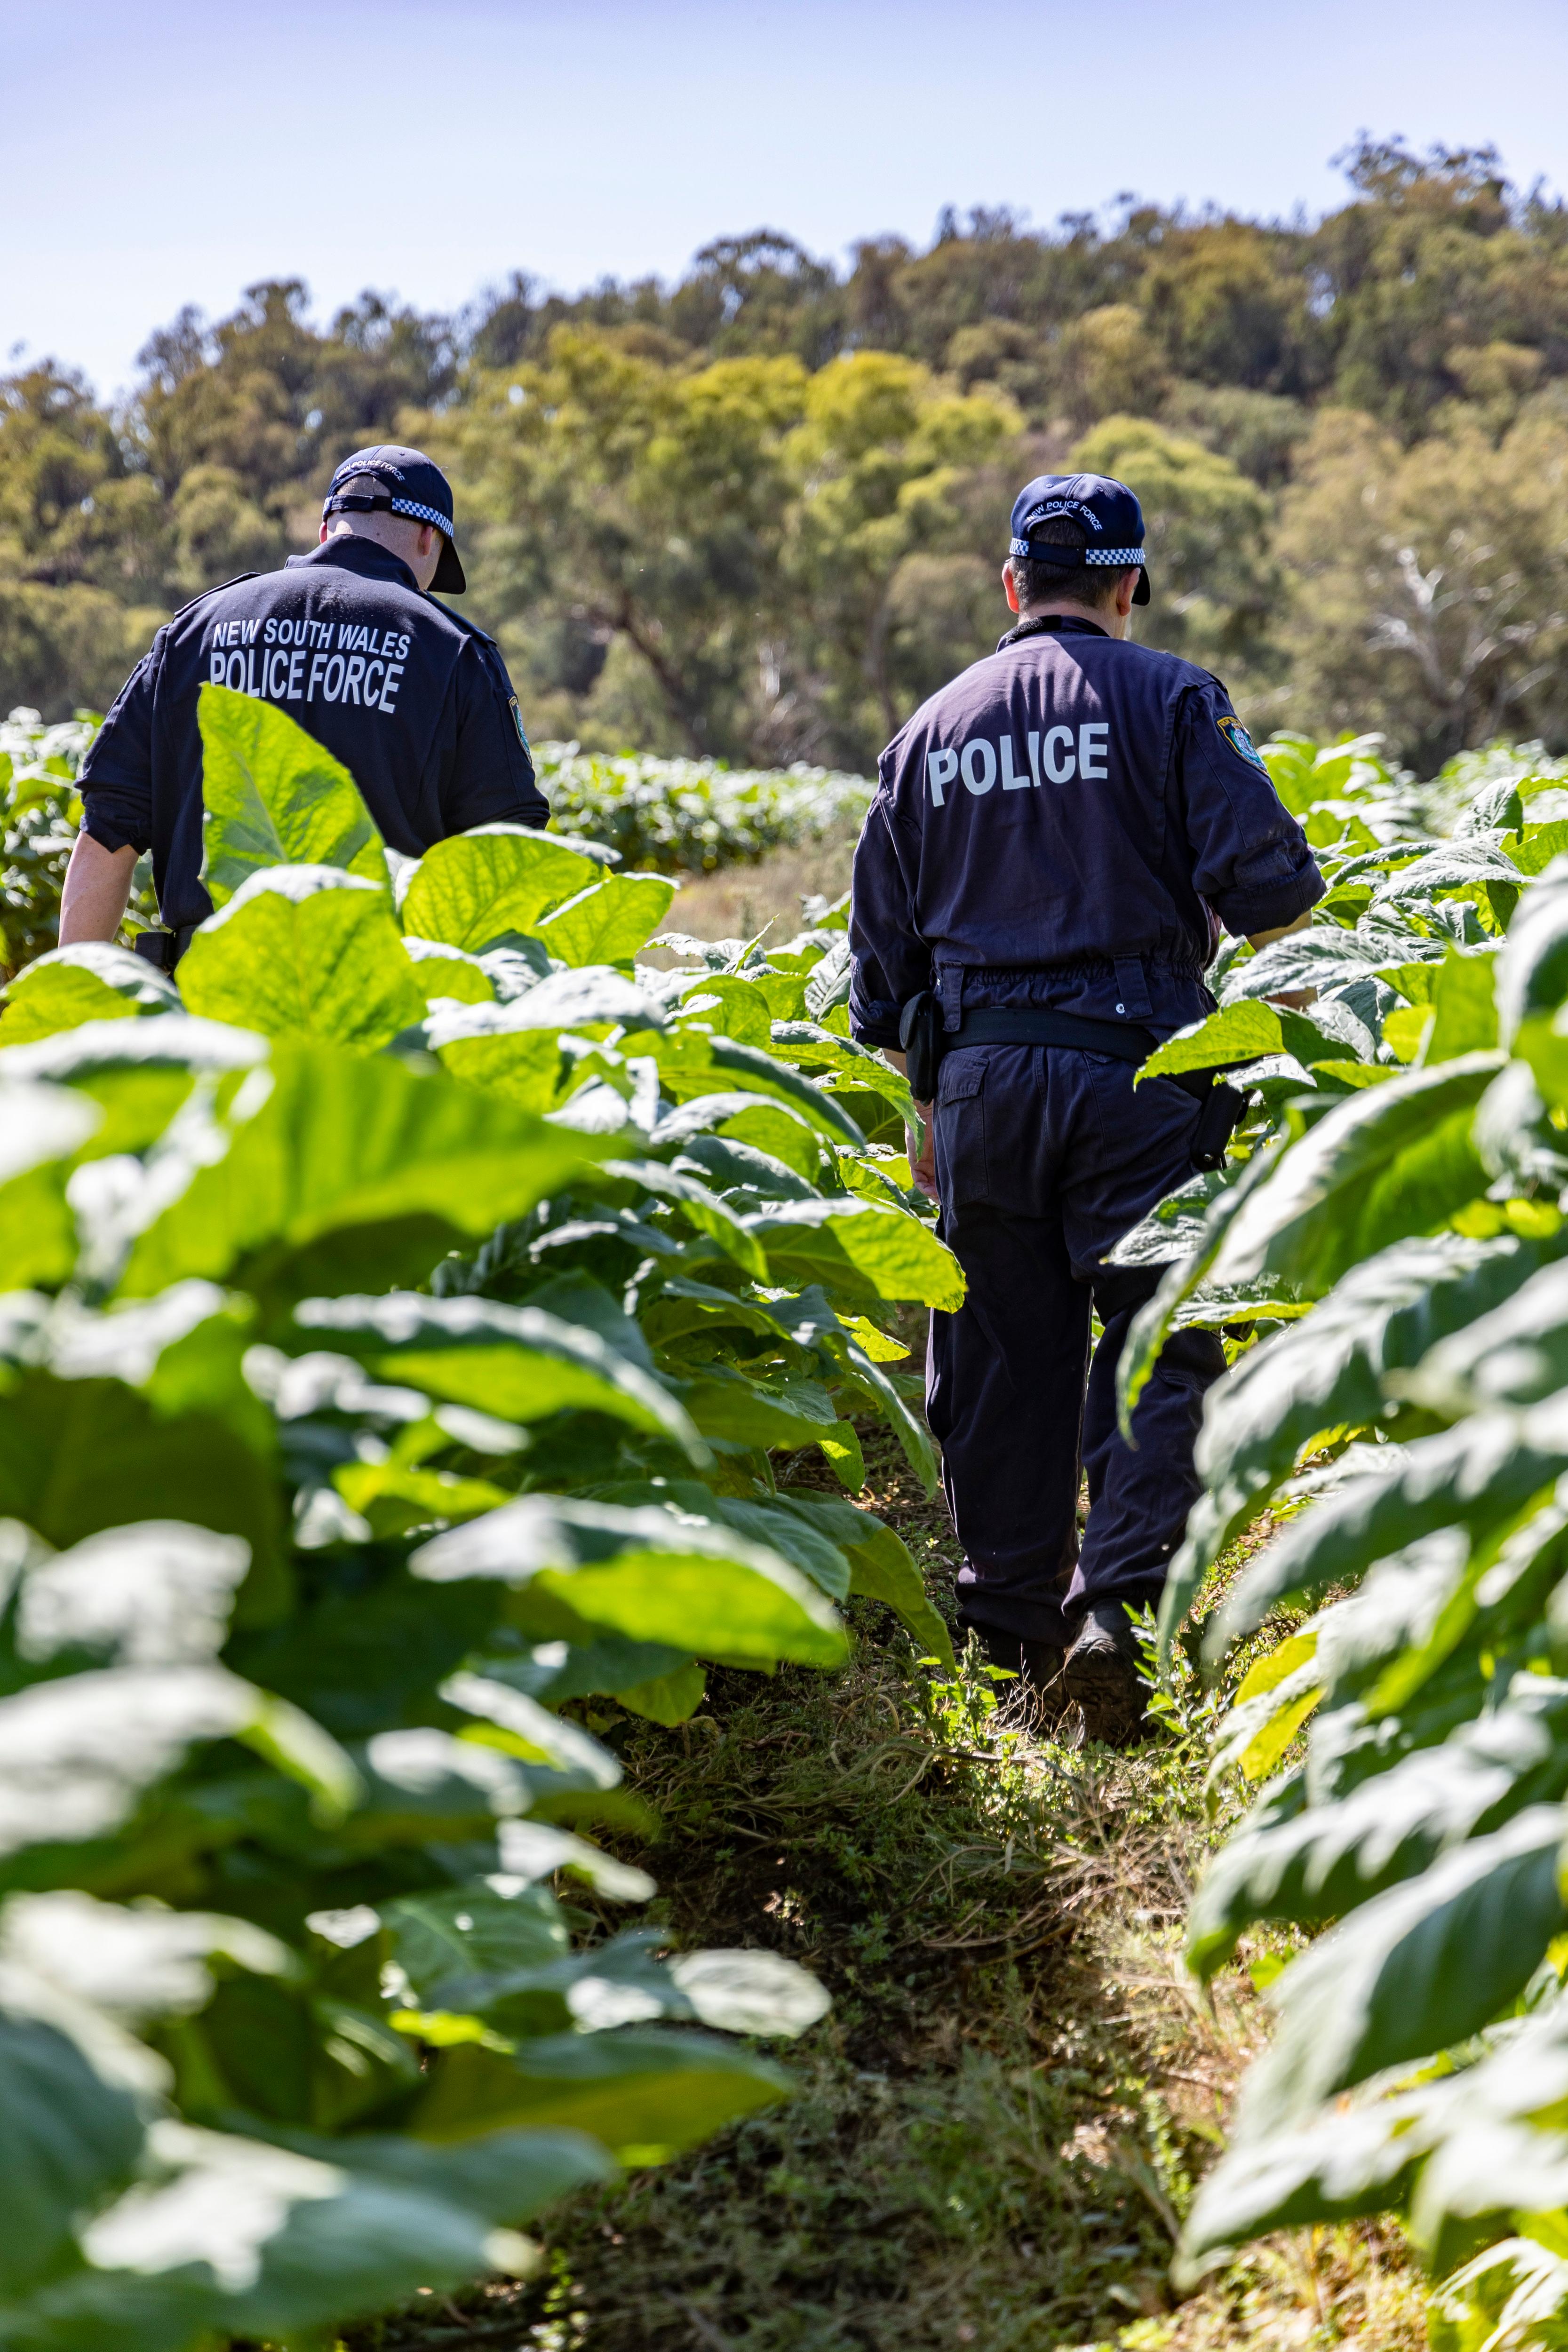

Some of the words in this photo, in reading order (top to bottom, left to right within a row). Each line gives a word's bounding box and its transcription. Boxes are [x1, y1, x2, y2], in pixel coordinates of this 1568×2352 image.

[381, 462, 406, 481] FORCE
[1026, 504, 1044, 521] NSW
[1047, 501, 1080, 509] POLICE
[1079, 505, 1103, 531] FORCE
[212, 619, 261, 648] NEW
[264, 618, 334, 649] SOUTH
[338, 624, 411, 660] WALES
[210, 649, 307, 699] POLICE
[307, 653, 405, 714] FORCE
[928, 723, 1109, 807] POLICE
